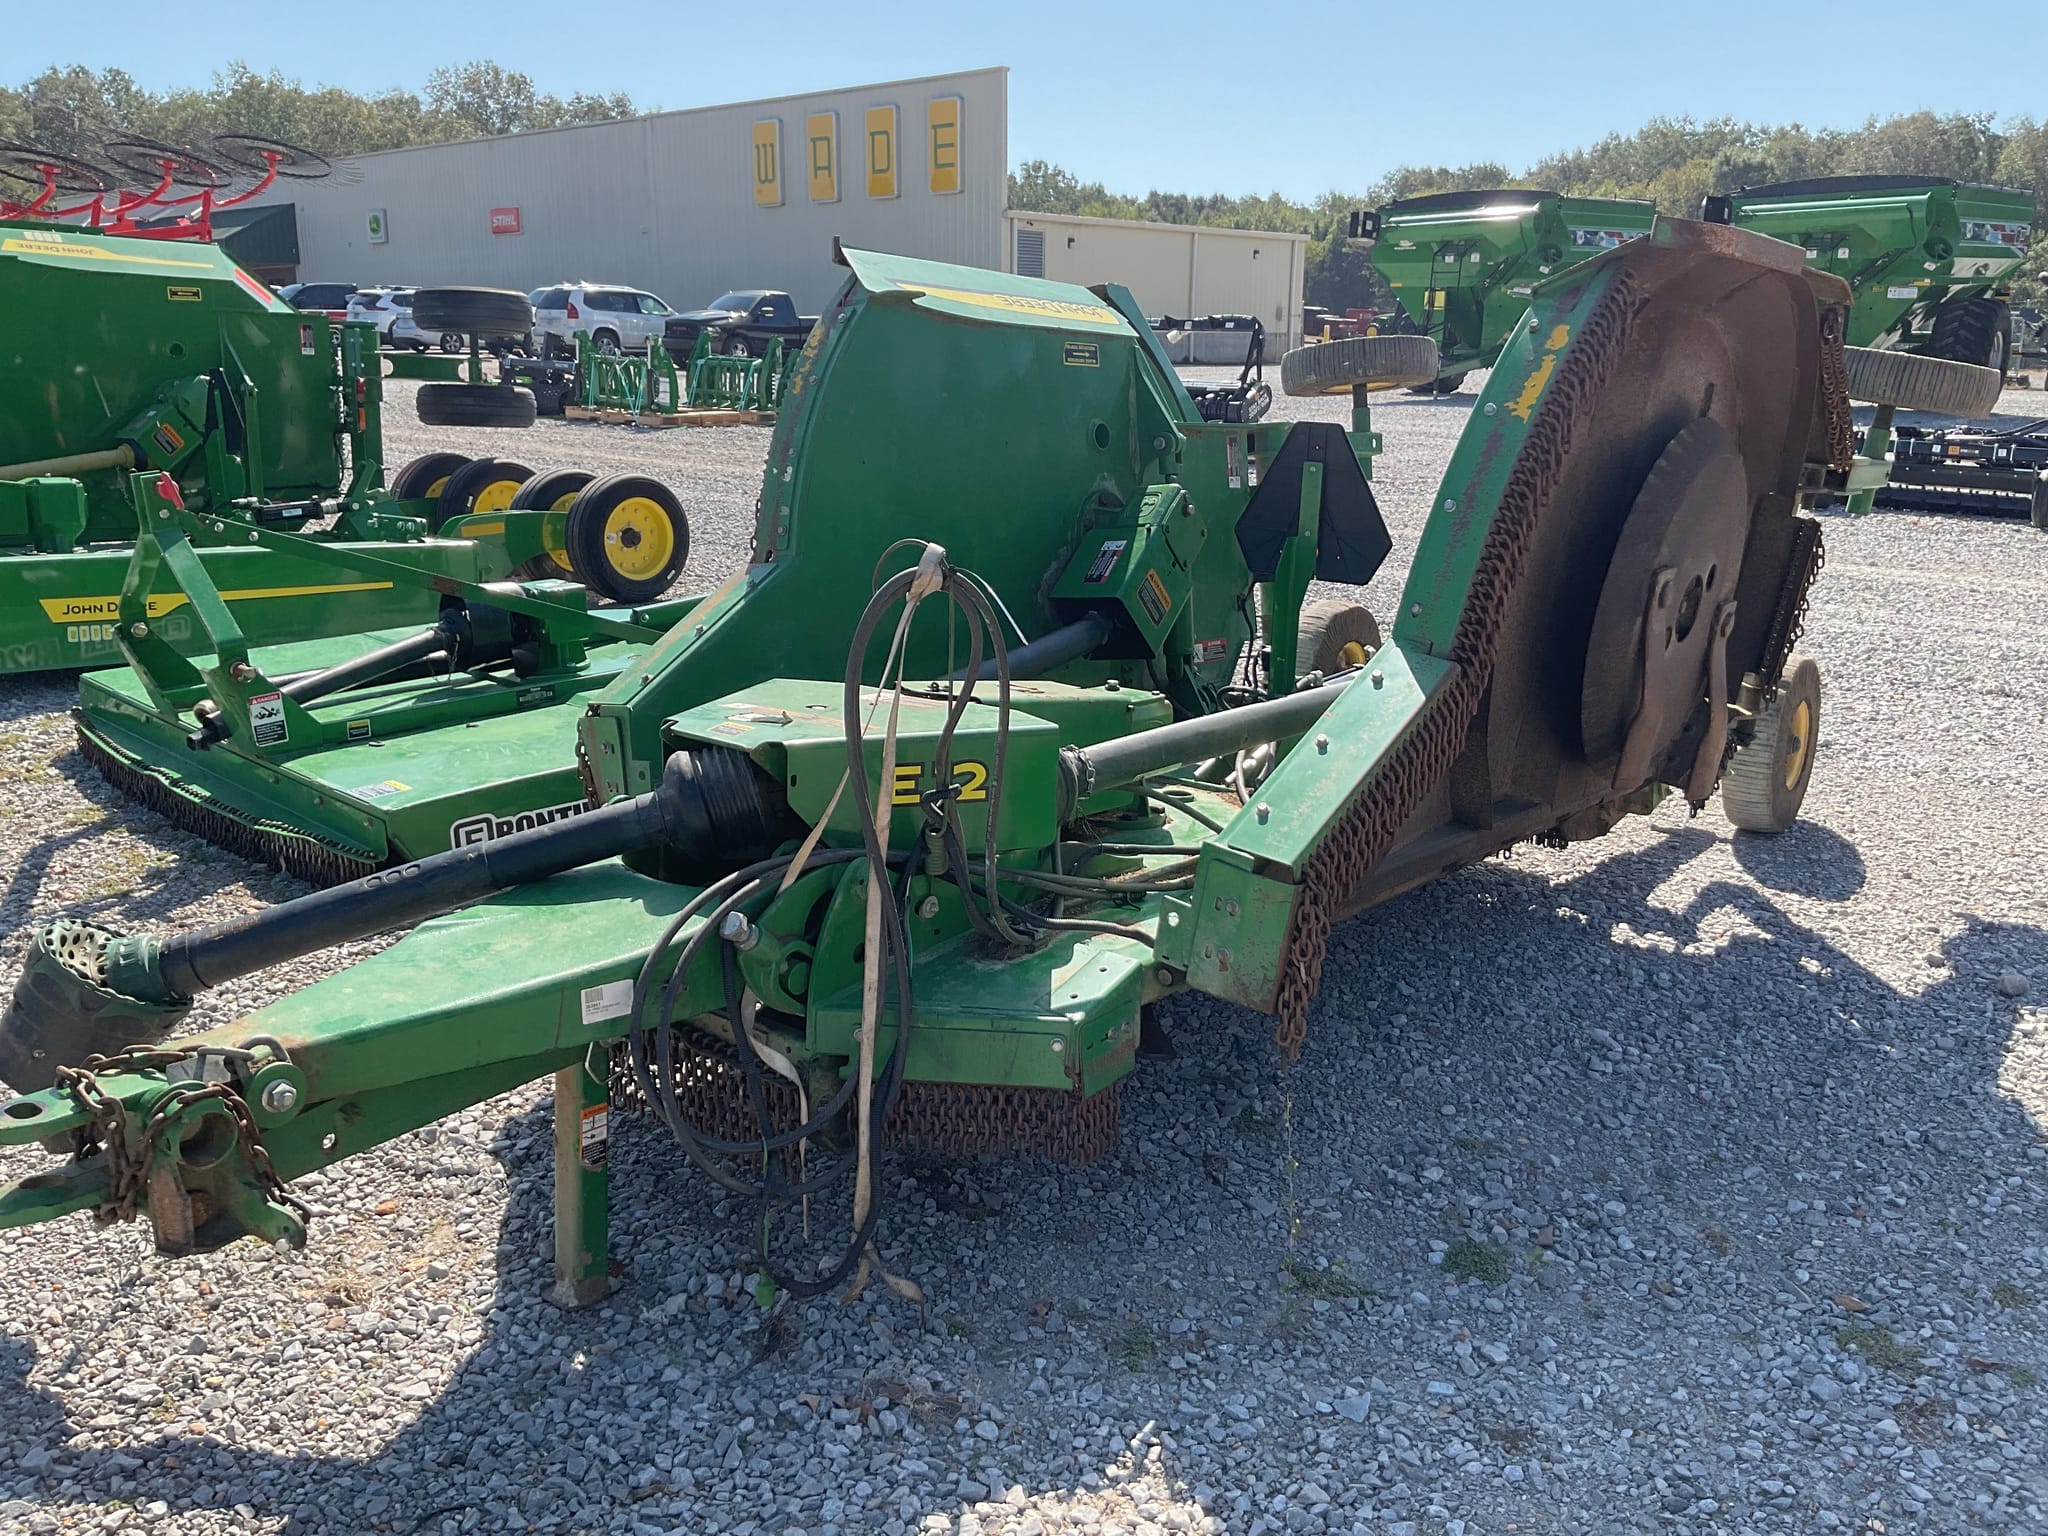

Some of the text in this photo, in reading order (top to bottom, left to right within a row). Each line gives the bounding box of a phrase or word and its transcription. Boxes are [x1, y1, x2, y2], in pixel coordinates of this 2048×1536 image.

[755, 122, 955, 184] WADE
[492, 214, 518, 227] STIHL
[62, 602, 103, 615] JOHN
